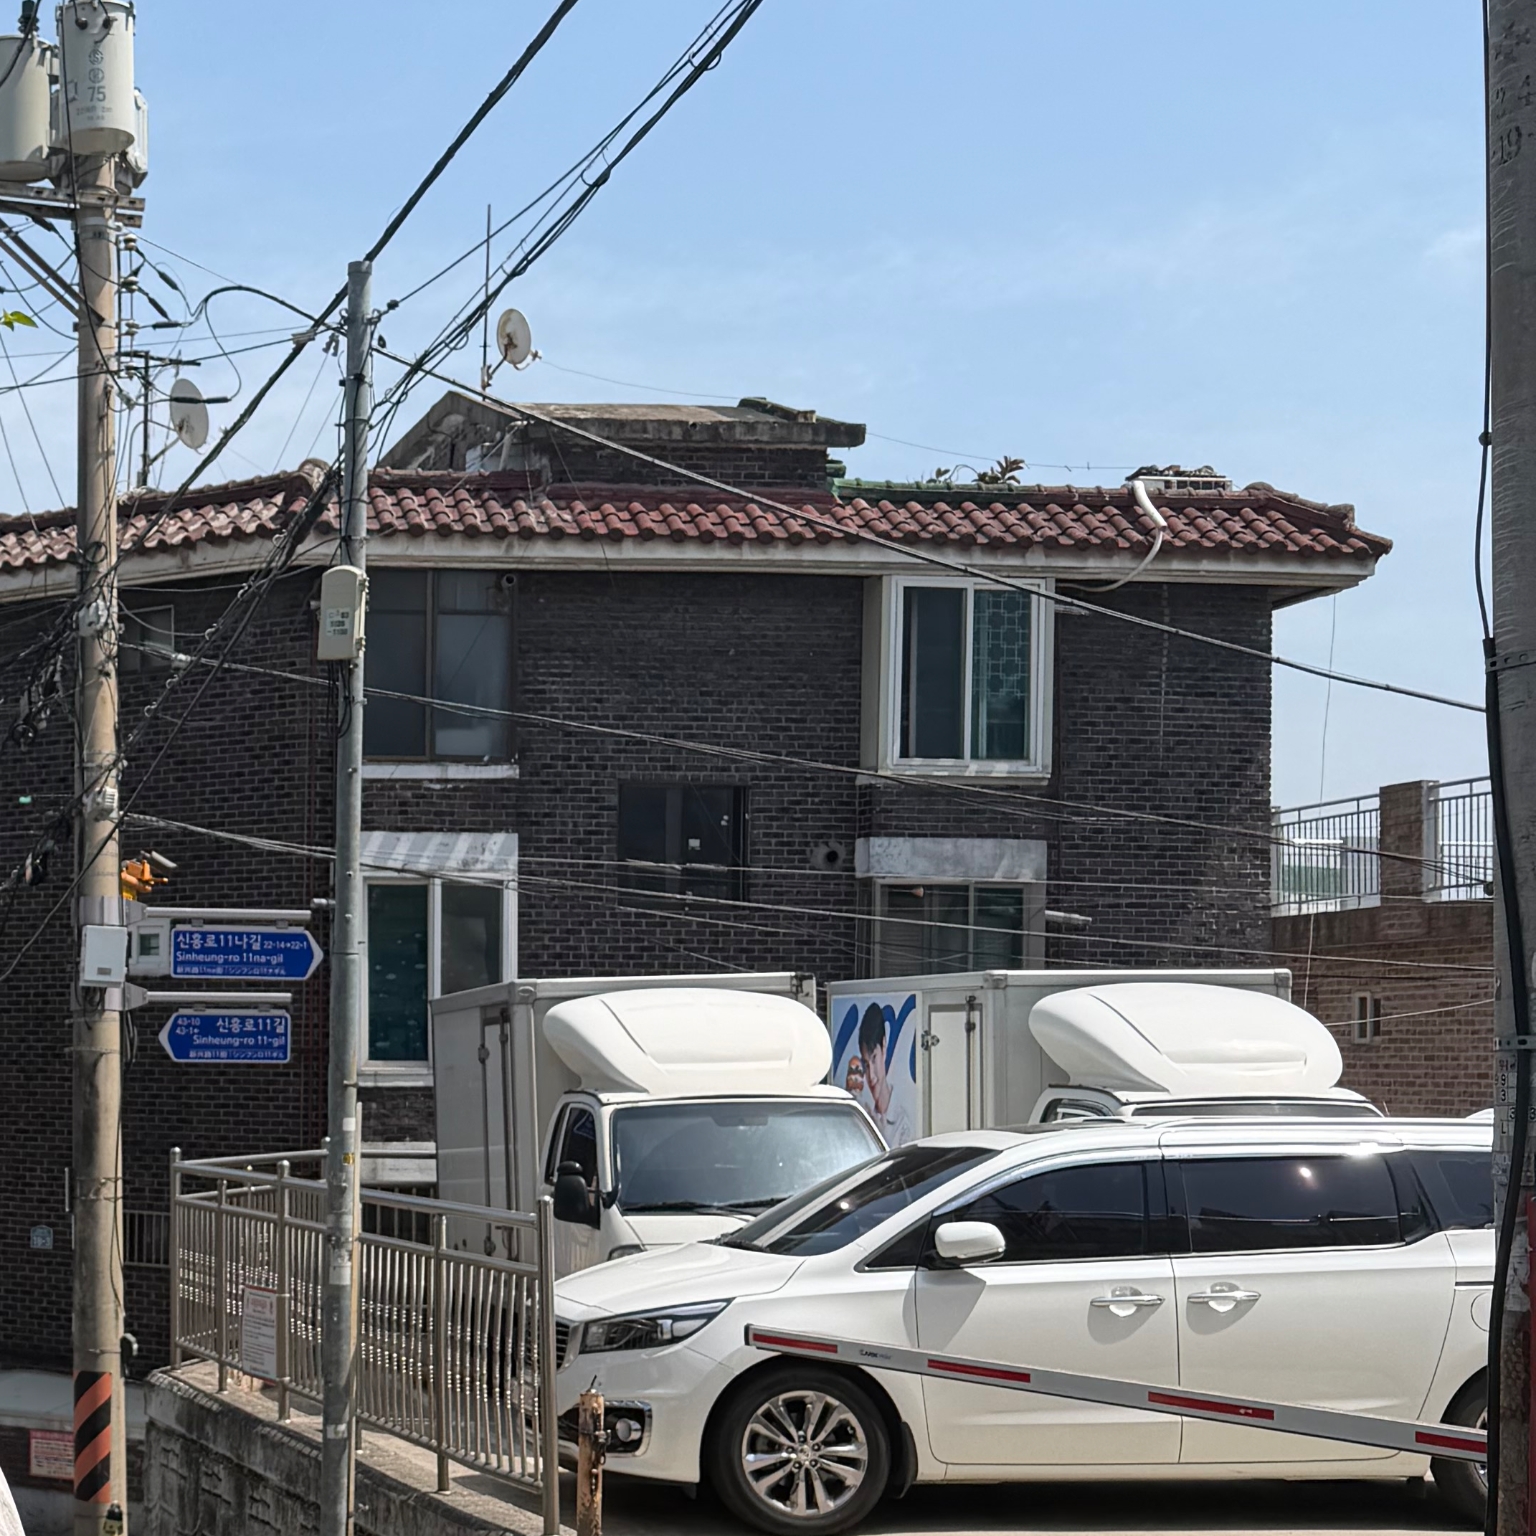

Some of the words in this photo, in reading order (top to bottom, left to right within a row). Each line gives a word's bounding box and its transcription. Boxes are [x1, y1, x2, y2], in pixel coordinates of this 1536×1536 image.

[87, 85, 106, 103] 75
[176, 933, 261, 951] 신흥로11나길
[176, 951, 240, 964] Sinheung-ro
[242, 951, 284, 964] 11na-gil
[216, 1017, 285, 1033] 신흥로11길
[193, 1035, 255, 1046] Sinheung-ro
[257, 1035, 285, 1047] 11-gil
